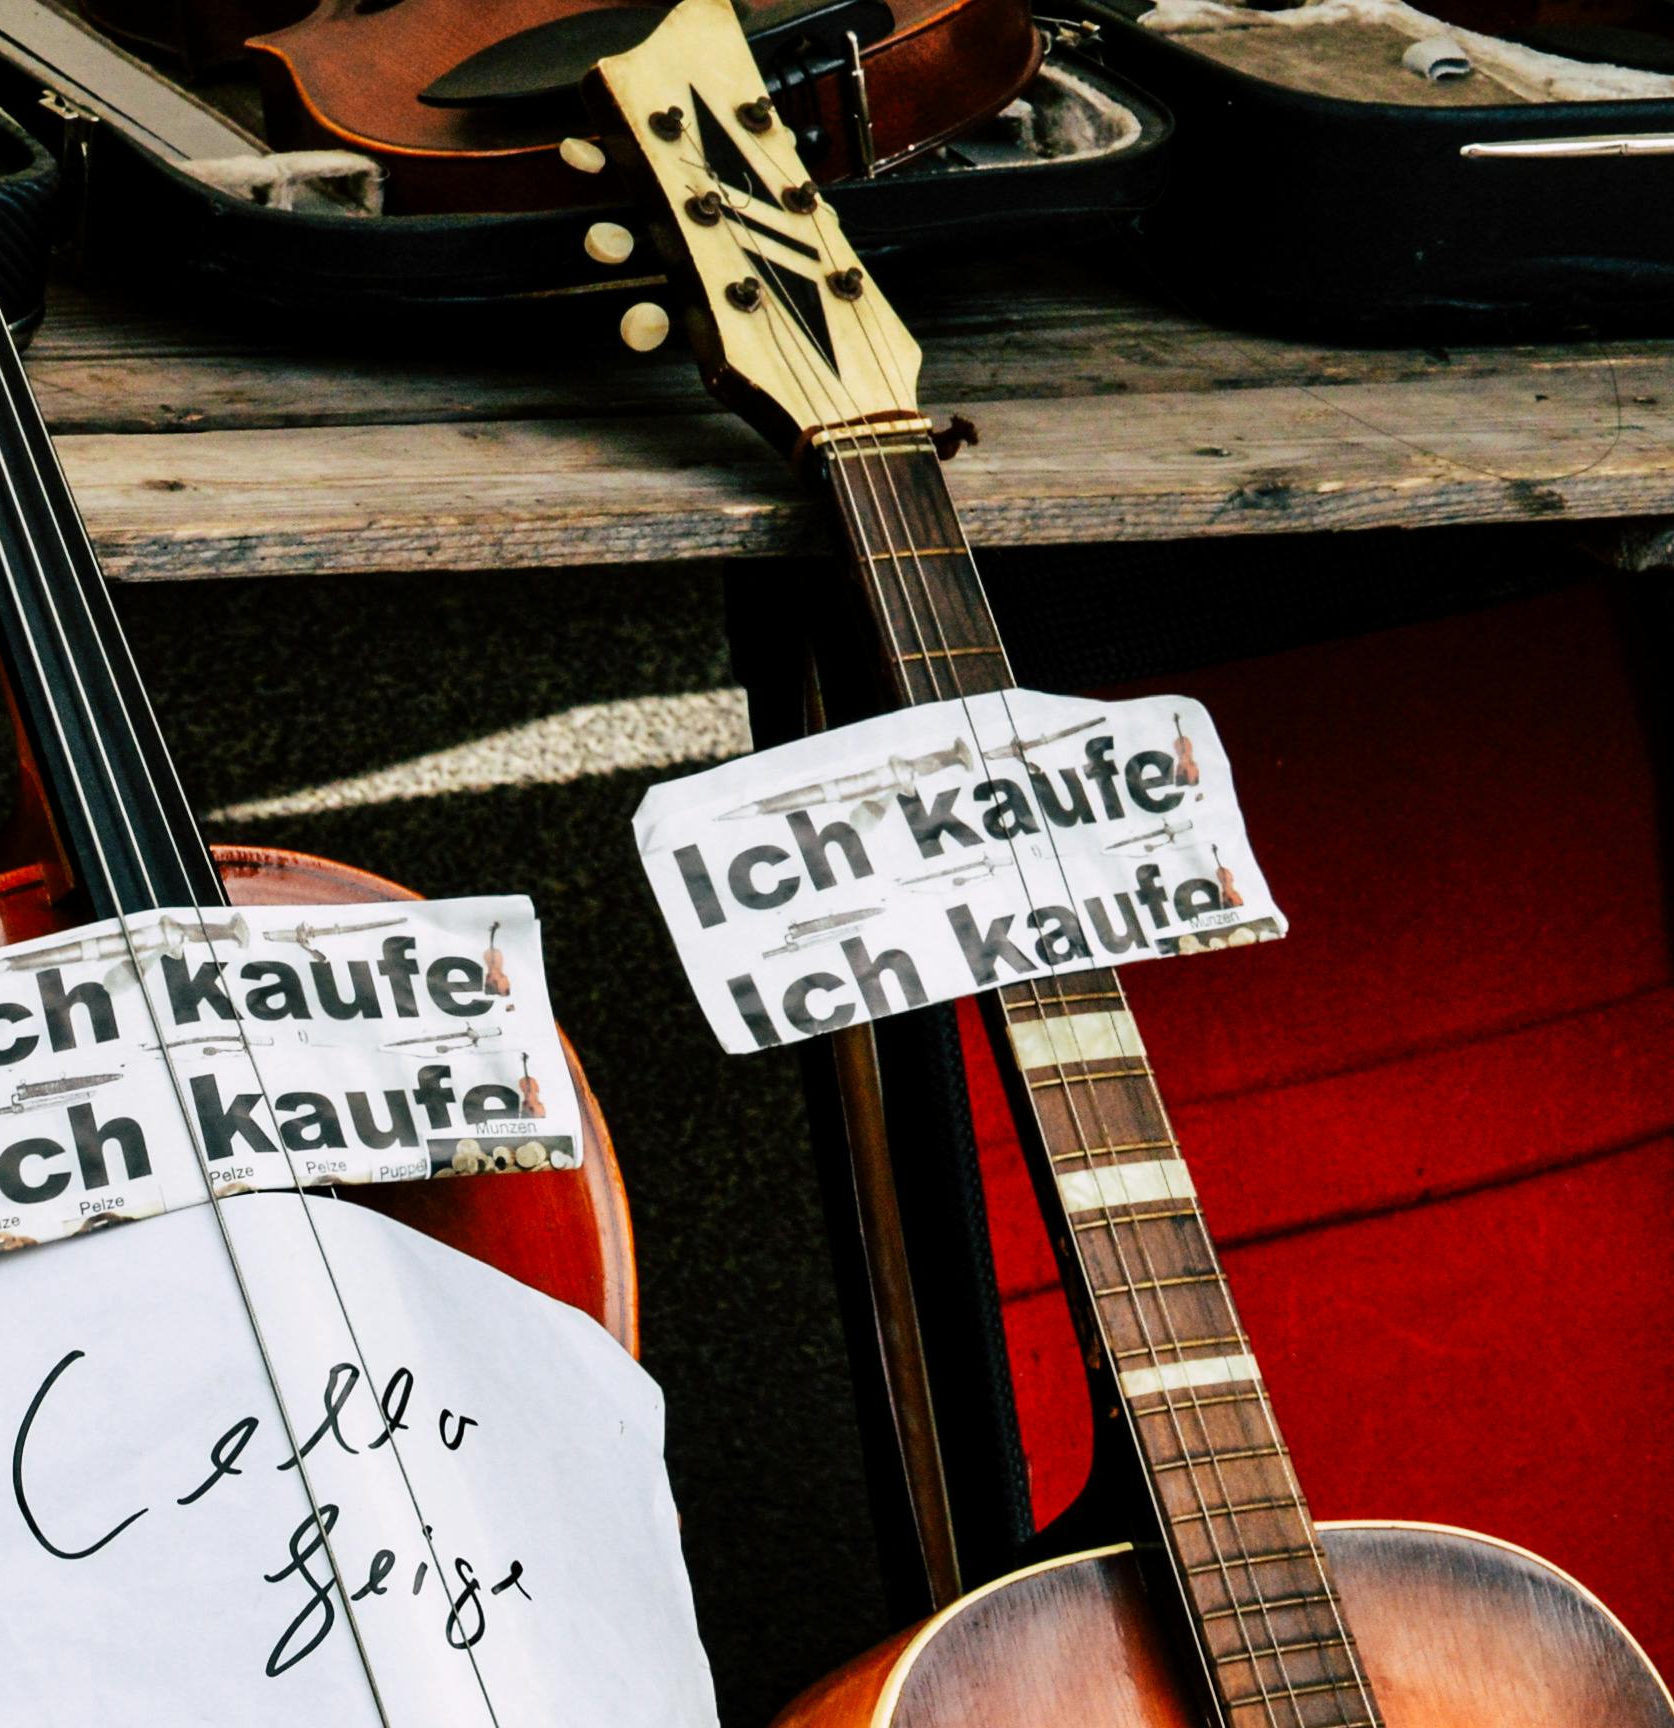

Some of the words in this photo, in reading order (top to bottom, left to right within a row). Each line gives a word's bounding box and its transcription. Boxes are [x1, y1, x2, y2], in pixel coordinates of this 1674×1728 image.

[673, 810, 874, 930] Ich
[896, 736, 1186, 859] kaufe
[163, 936, 494, 1026] kaufe
[727, 936, 929, 1048] Ich
[946, 863, 1221, 986] kaufe
[189, 1065, 521, 1162] kaufe
[78, 1193, 126, 1217] Pelze
[209, 1165, 255, 1184] Pelze
[306, 1160, 348, 1175] Pelze
